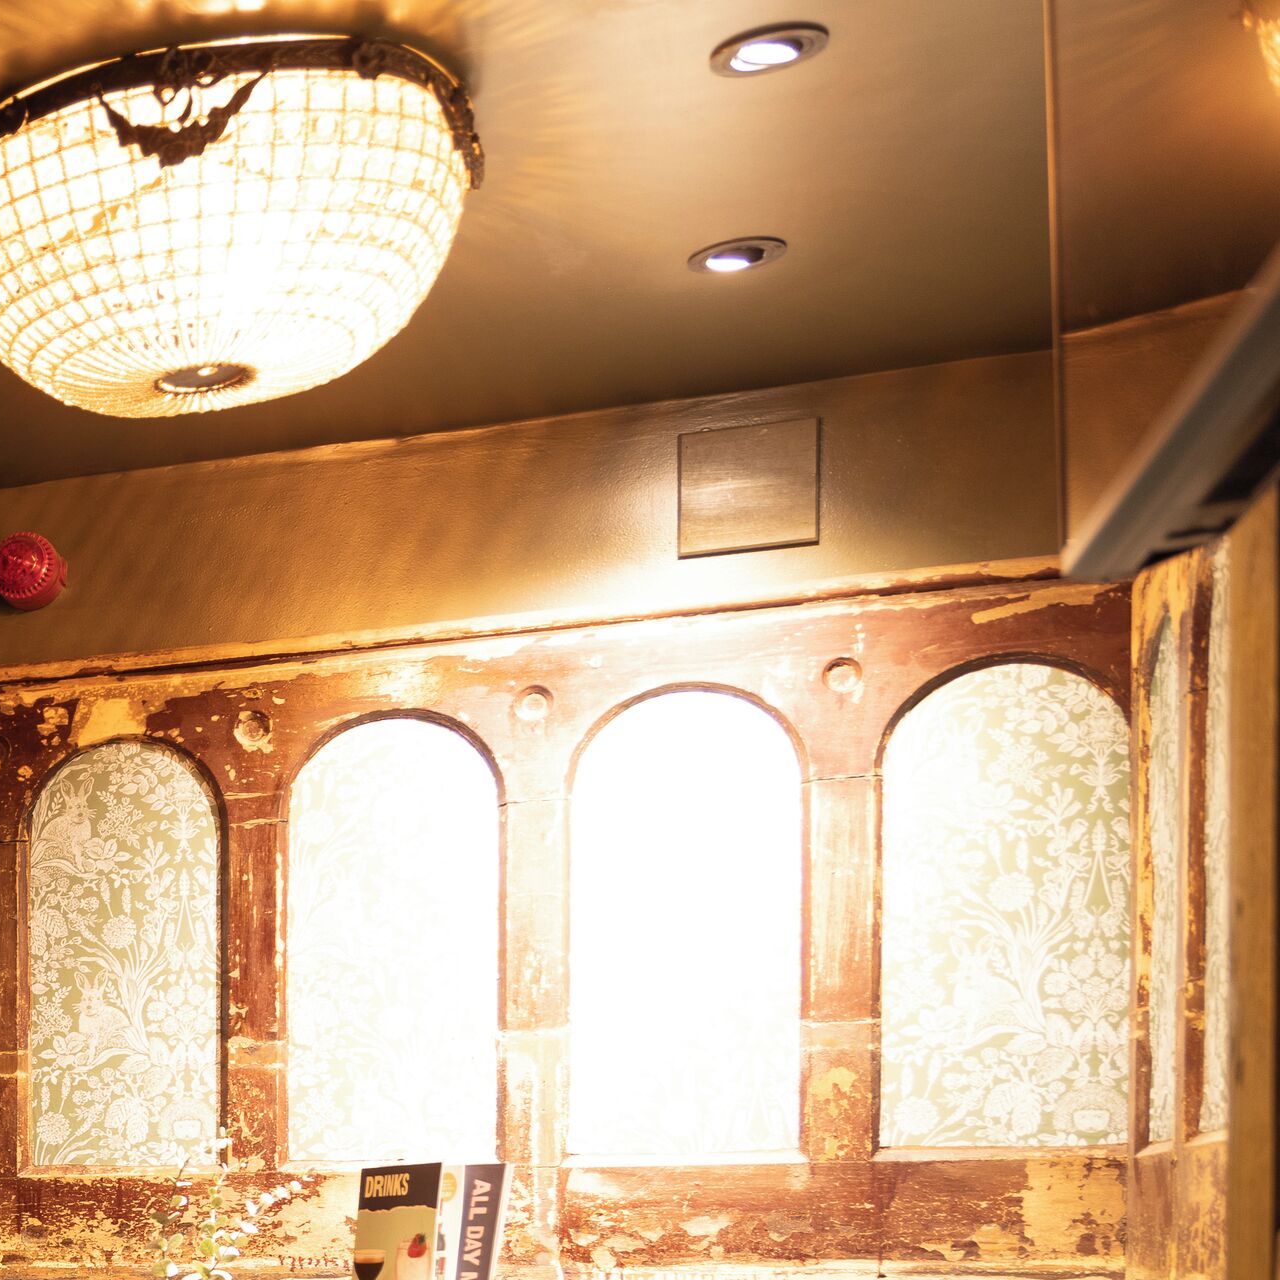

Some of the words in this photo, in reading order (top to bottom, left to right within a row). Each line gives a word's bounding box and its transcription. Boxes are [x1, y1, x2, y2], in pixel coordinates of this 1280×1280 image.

[365, 1173, 410, 1198] DRINKS
[467, 1179, 491, 1221] ALL
[463, 1226, 485, 1266] DAY
